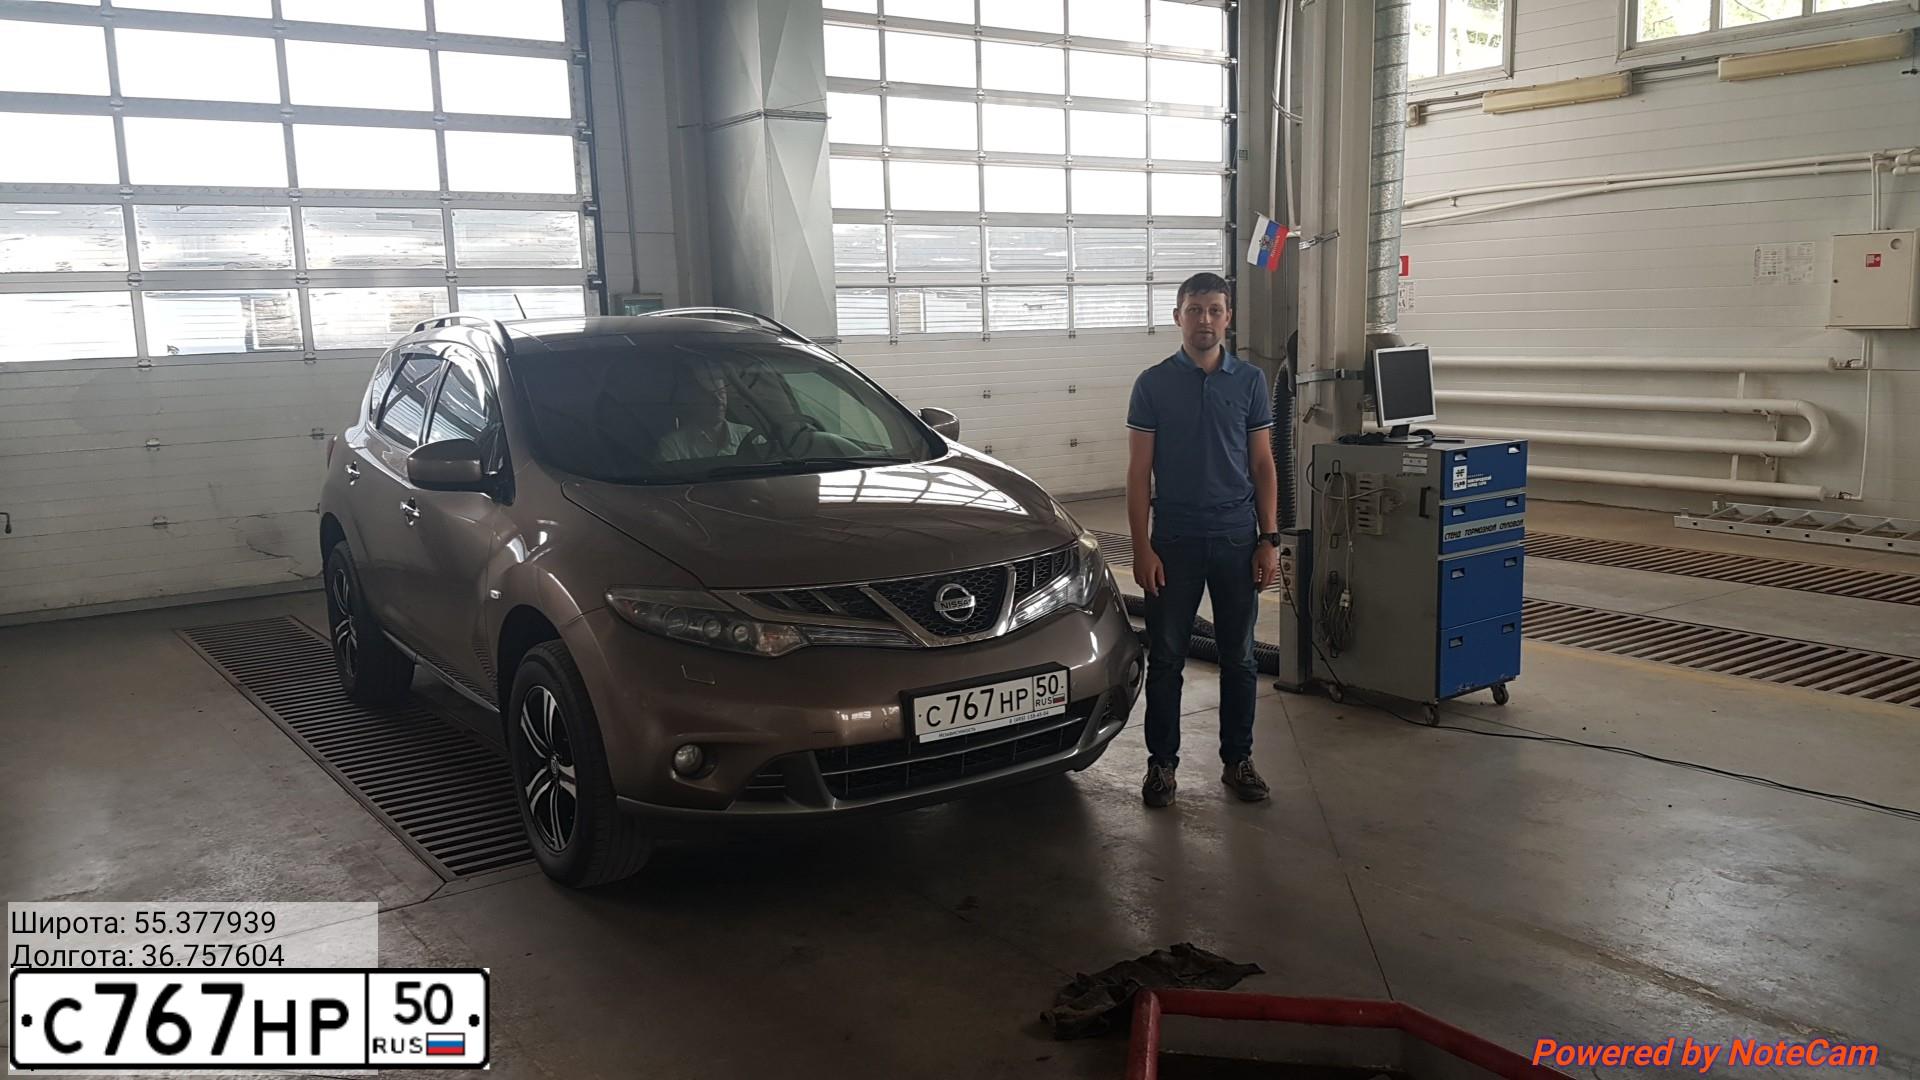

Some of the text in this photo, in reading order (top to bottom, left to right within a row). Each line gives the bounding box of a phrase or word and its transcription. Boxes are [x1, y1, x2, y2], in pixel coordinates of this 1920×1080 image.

[941, 599, 972, 609] NISSA
[1036, 674, 1059, 698] 50
[1035, 697, 1053, 708] RUS
